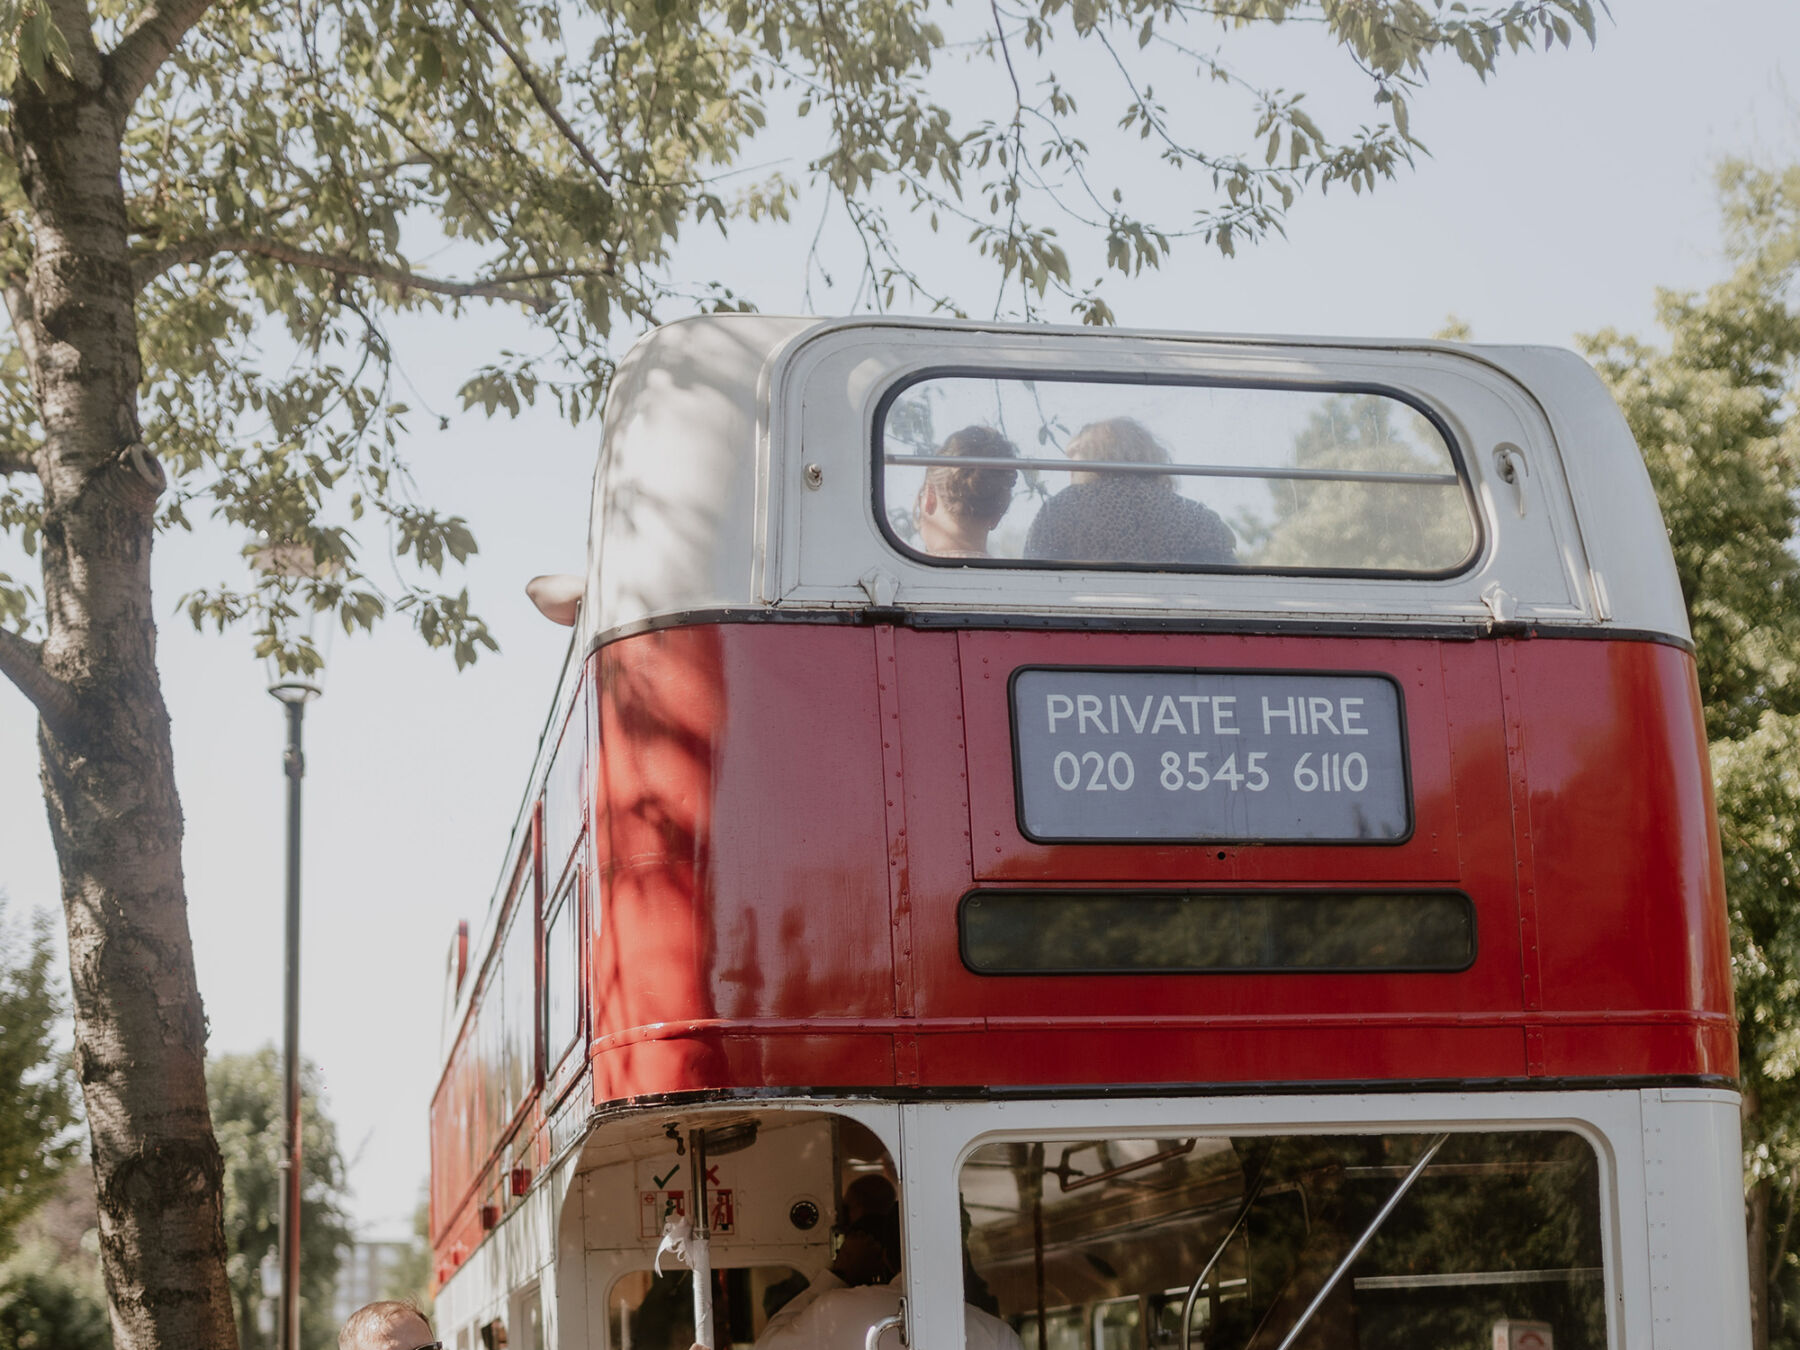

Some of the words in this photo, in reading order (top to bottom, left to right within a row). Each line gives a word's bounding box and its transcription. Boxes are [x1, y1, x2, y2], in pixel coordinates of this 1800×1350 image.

[1046, 694, 1240, 735] PRIVATE
[1261, 696, 1369, 735] HIRE
[1053, 751, 1135, 792] 020
[1159, 751, 1270, 792] 8545
[1294, 752, 1368, 792] 6110
